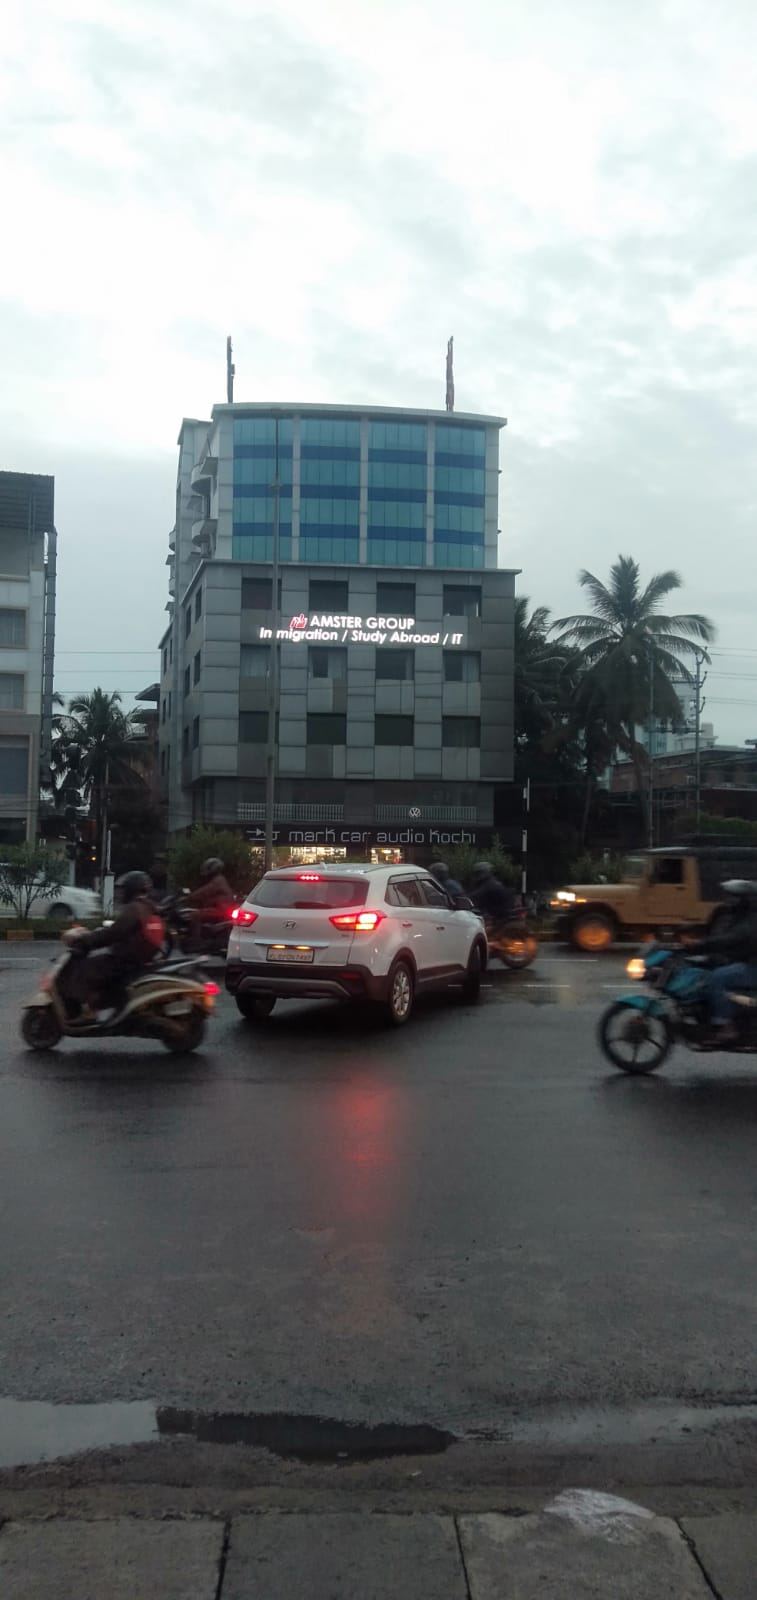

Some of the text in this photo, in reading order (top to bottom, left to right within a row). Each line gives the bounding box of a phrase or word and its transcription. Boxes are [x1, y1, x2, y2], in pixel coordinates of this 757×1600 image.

[310, 615, 415, 630] AMSTER GROUP
[351, 630, 387, 644] Study
[389, 631, 440, 644] Abroad
[451, 633, 464, 645] IT
[340, 831, 371, 843] car
[376, 828, 425, 843] audio
